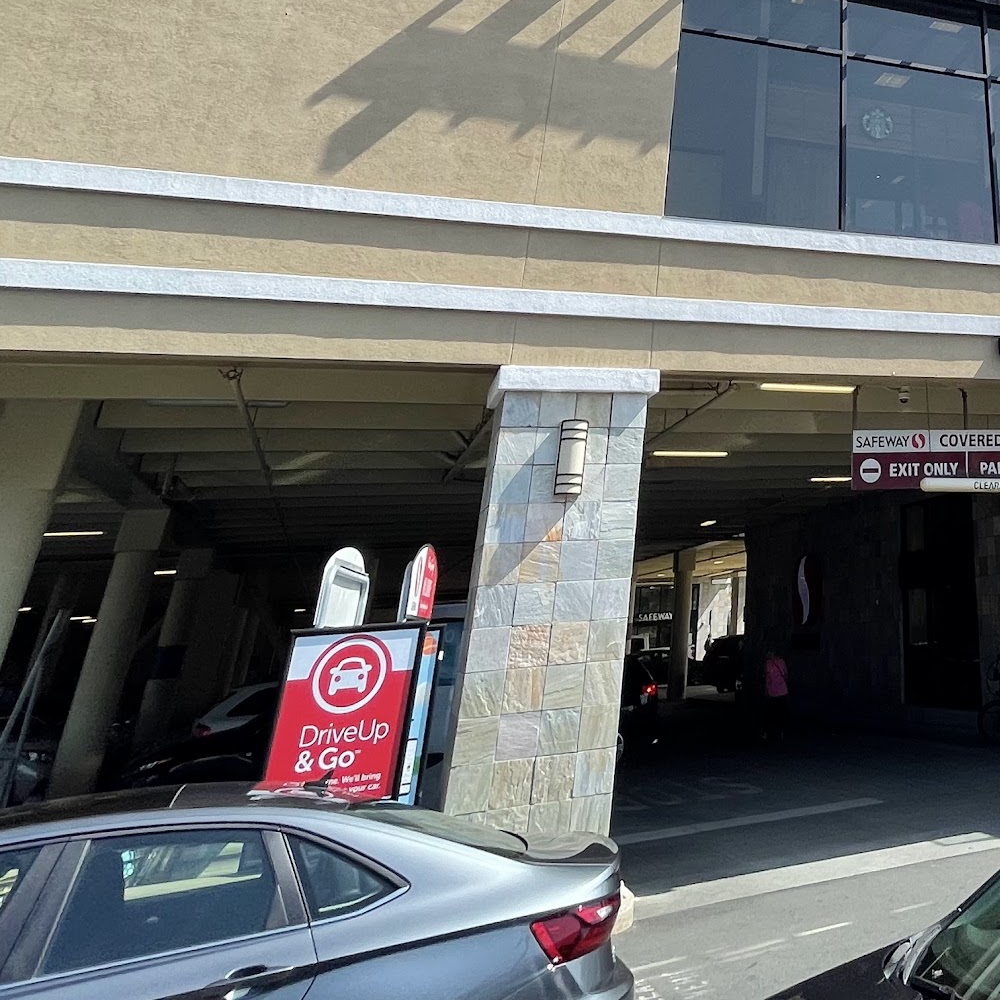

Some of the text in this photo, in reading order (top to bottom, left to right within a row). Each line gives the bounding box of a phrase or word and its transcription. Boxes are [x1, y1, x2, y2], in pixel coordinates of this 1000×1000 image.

[855, 435, 910, 448] SAFEWAY
[889, 461, 959, 477] EXIT ONLY
[299, 718, 390, 748] DriveUp
[294, 750, 315, 773] &
[361, 772, 382, 781] bring
